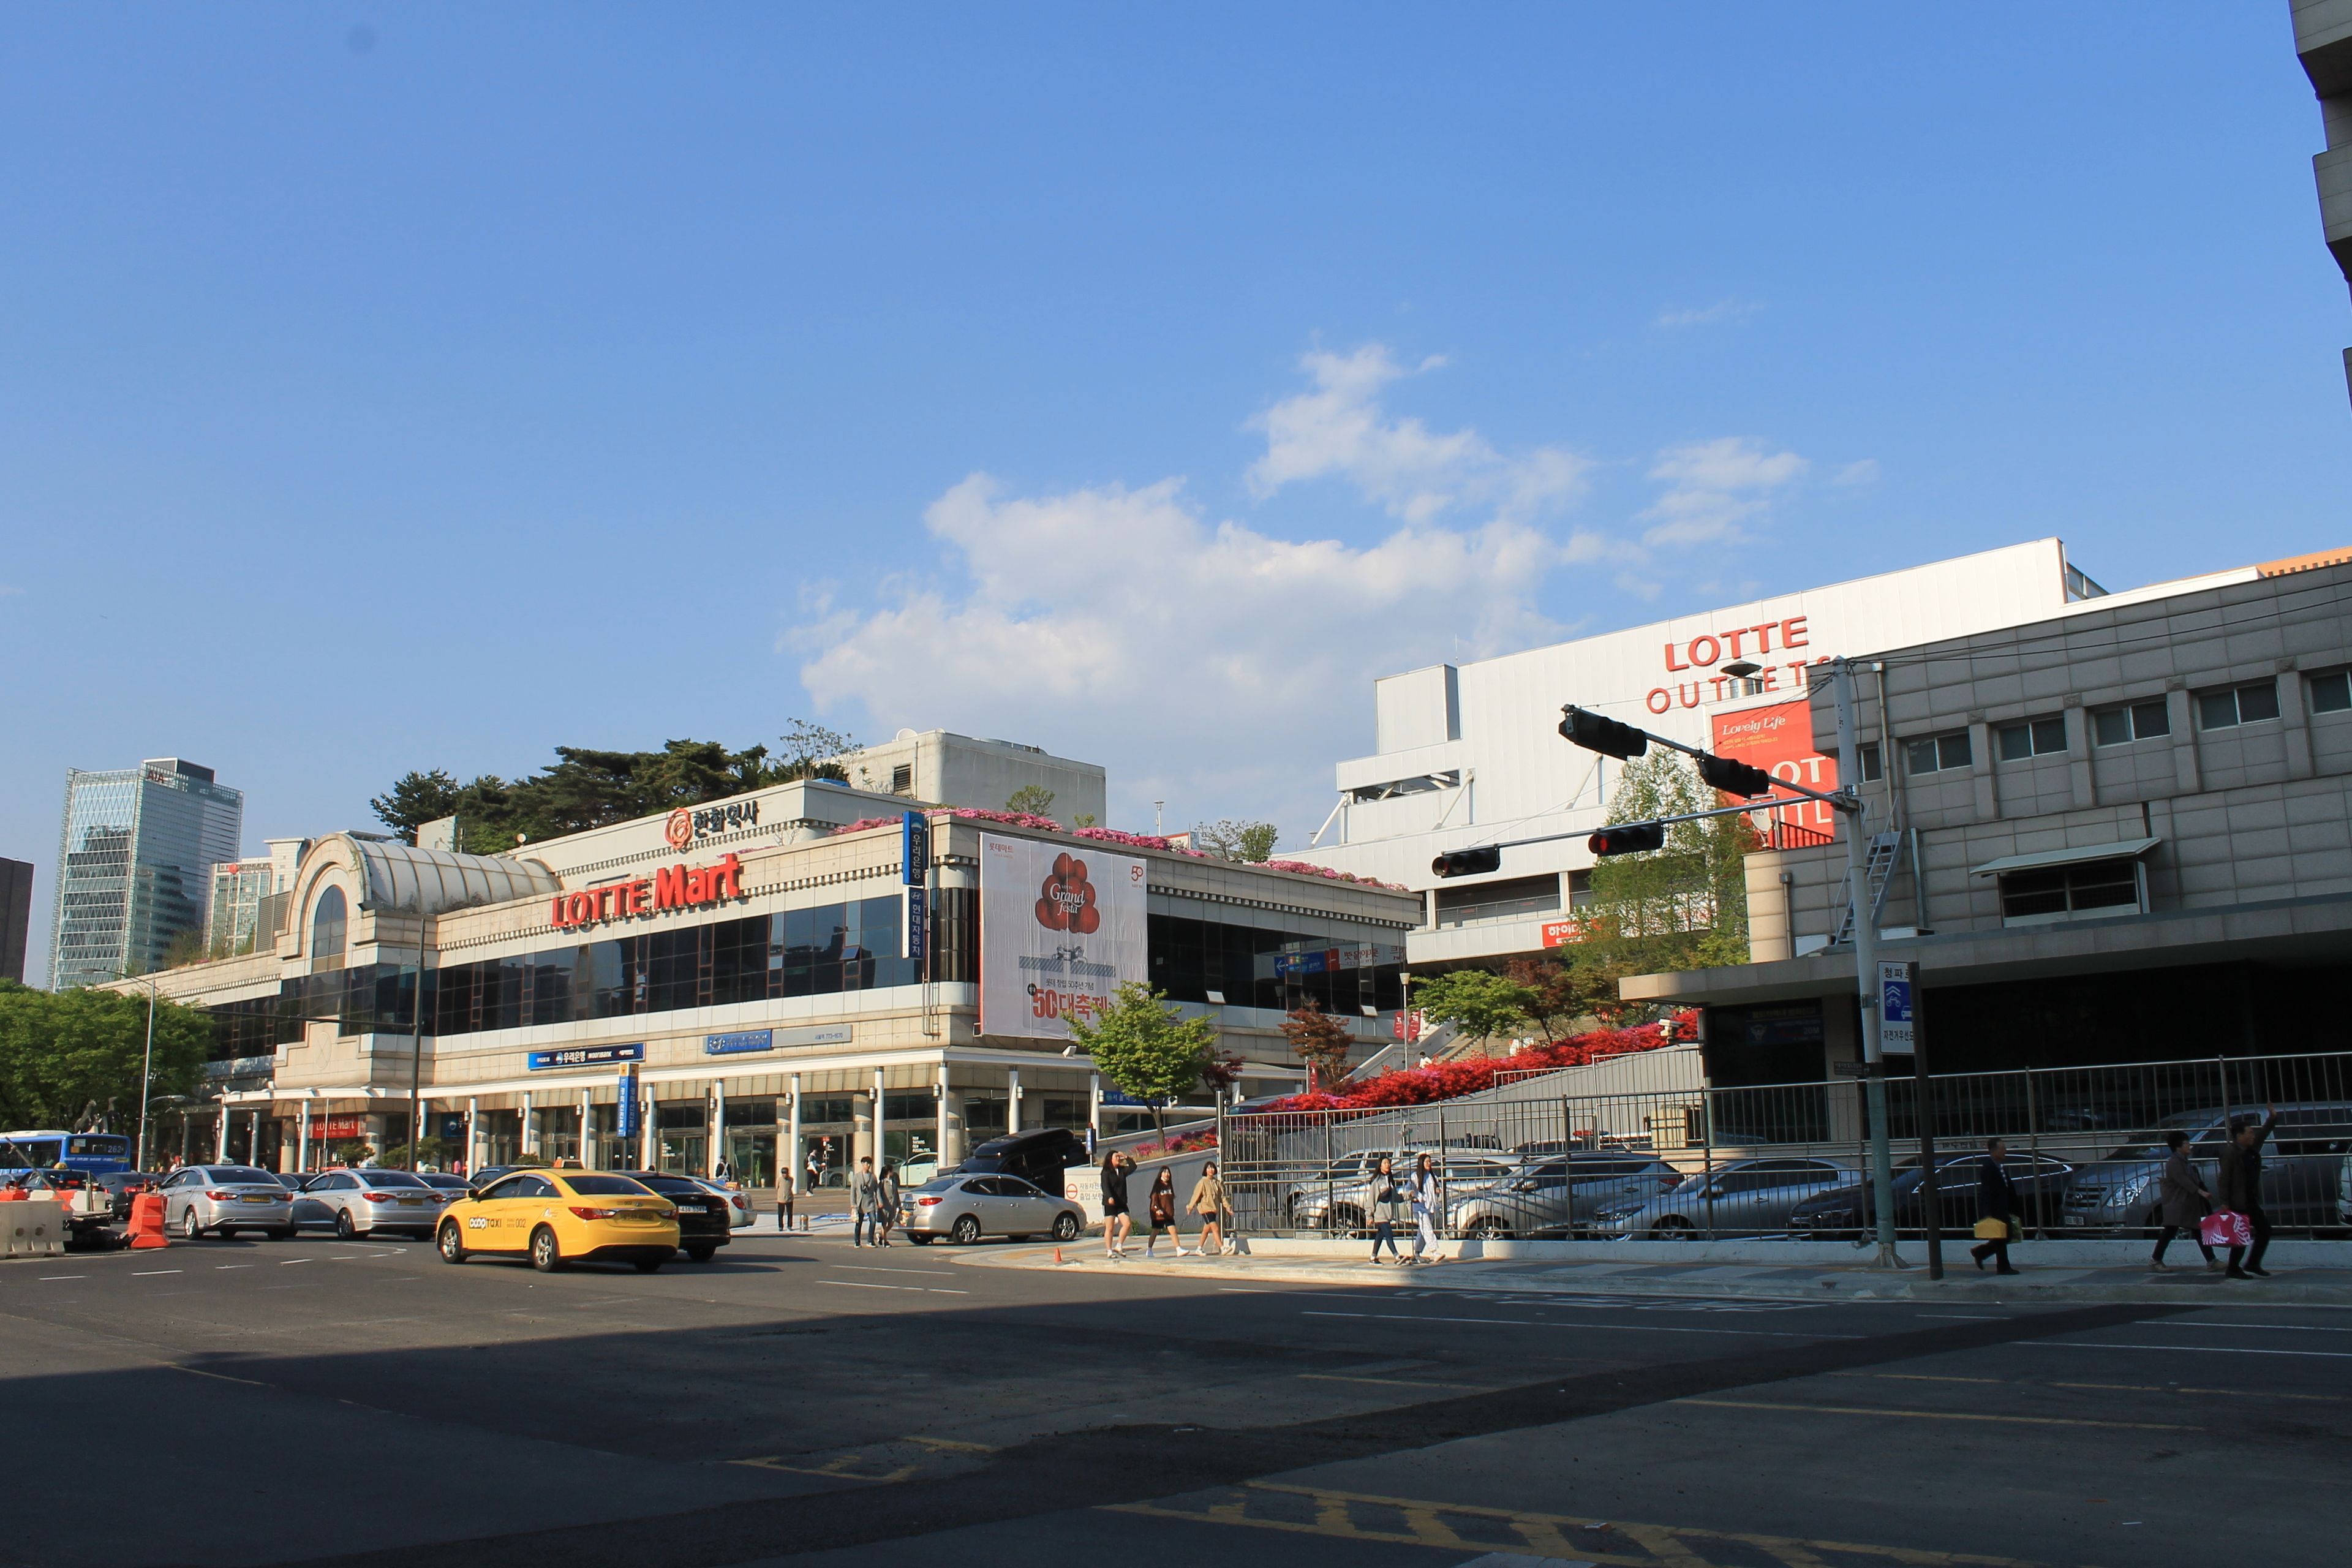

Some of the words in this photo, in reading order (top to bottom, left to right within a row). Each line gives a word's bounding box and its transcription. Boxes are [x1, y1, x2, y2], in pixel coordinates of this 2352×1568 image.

[1665, 616, 1809, 672] LOTTE
[1646, 656, 1831, 714] OUTET
[1722, 720, 1761, 735] Lovely
[1763, 715, 1786, 729] Life
[148, 771, 164, 783] AIA
[694, 800, 760, 839] 한화역사
[552, 879, 649, 927] LOTTE
[655, 853, 740, 910] Mart
[1050, 883, 1085, 907] Grand
[1057, 902, 1078, 916] festa
[912, 904, 921, 956] 현대자동차
[1057, 979, 1066, 988] 창립
[1068, 980, 1084, 990] 50주년
[1085, 982, 1095, 990] 기념
[564, 1051, 586, 1063] 우리은행
[316, 1122, 336, 1131] LOTE
